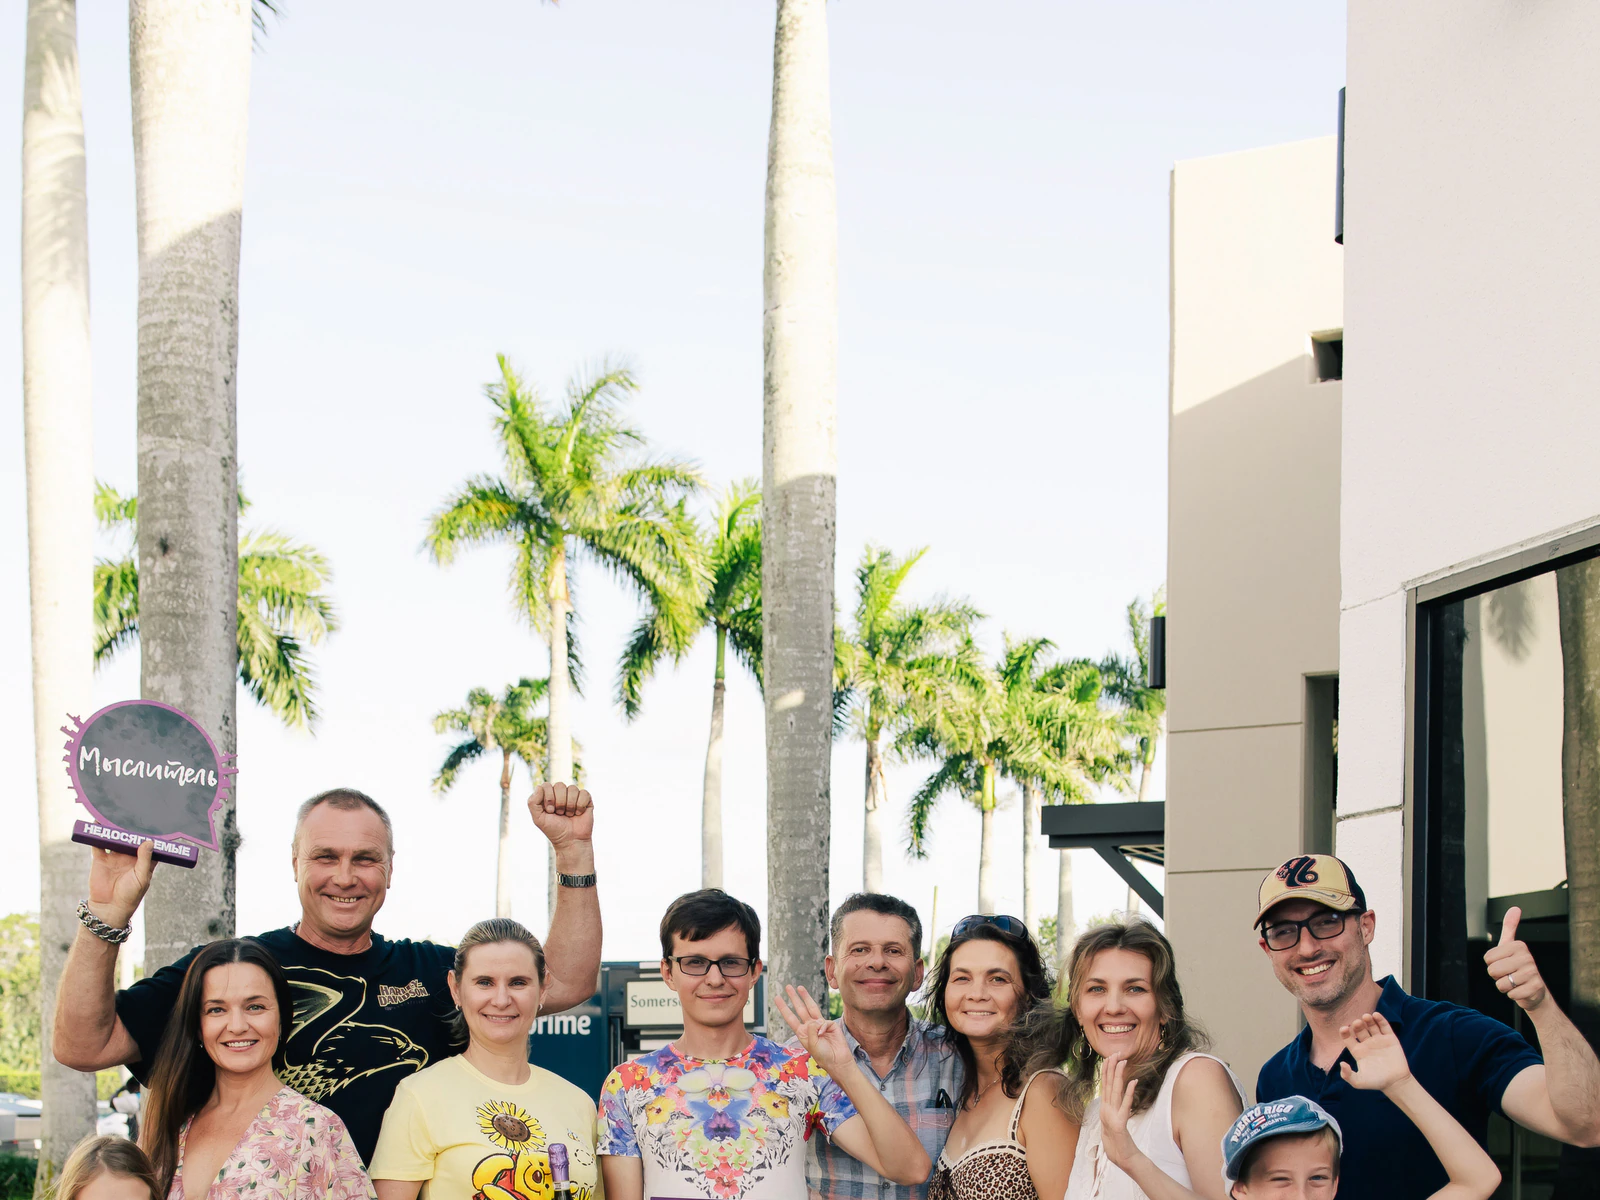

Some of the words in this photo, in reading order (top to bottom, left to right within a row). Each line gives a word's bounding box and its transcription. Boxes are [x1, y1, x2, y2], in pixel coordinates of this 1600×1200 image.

[79, 745, 218, 787] Мыслитель
[1230, 1106, 1262, 1143] PUERTO
[1264, 1104, 1294, 1114] RICO
